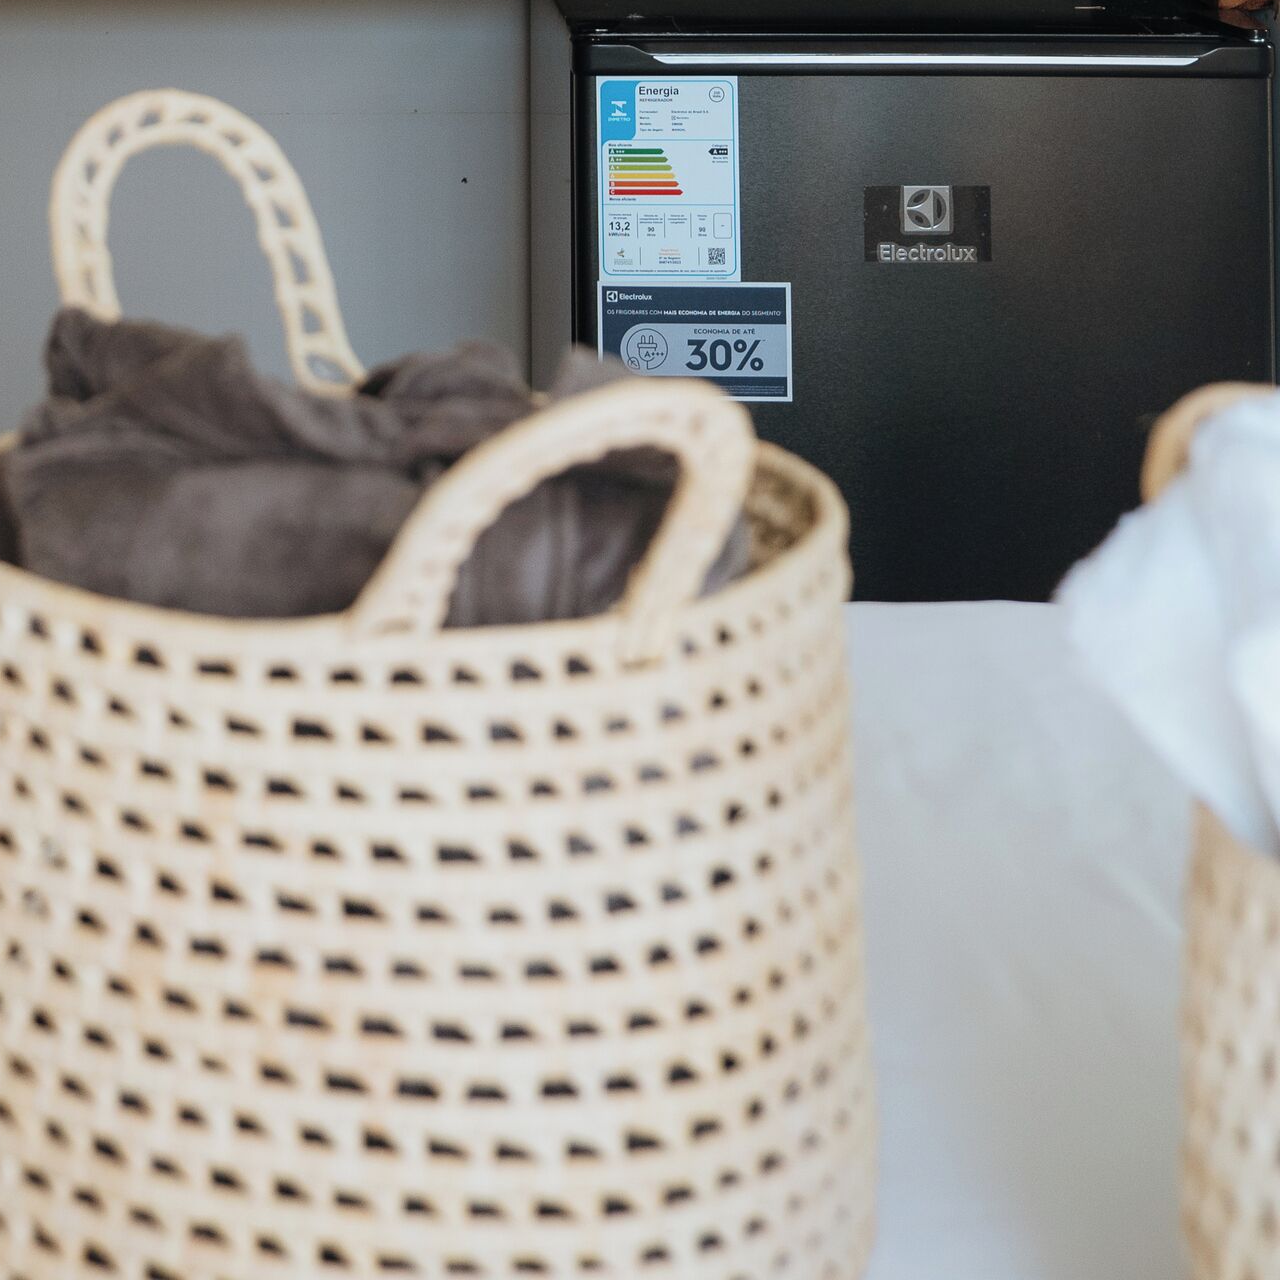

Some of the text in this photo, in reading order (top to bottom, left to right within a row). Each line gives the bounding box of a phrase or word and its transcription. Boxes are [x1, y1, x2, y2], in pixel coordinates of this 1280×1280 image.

[639, 86, 679, 97] Energia
[608, 221, 631, 232] 13,2
[879, 244, 976, 261] Electrolux
[743, 327, 756, 335] ATÉ
[685, 338, 764, 371] 30%
